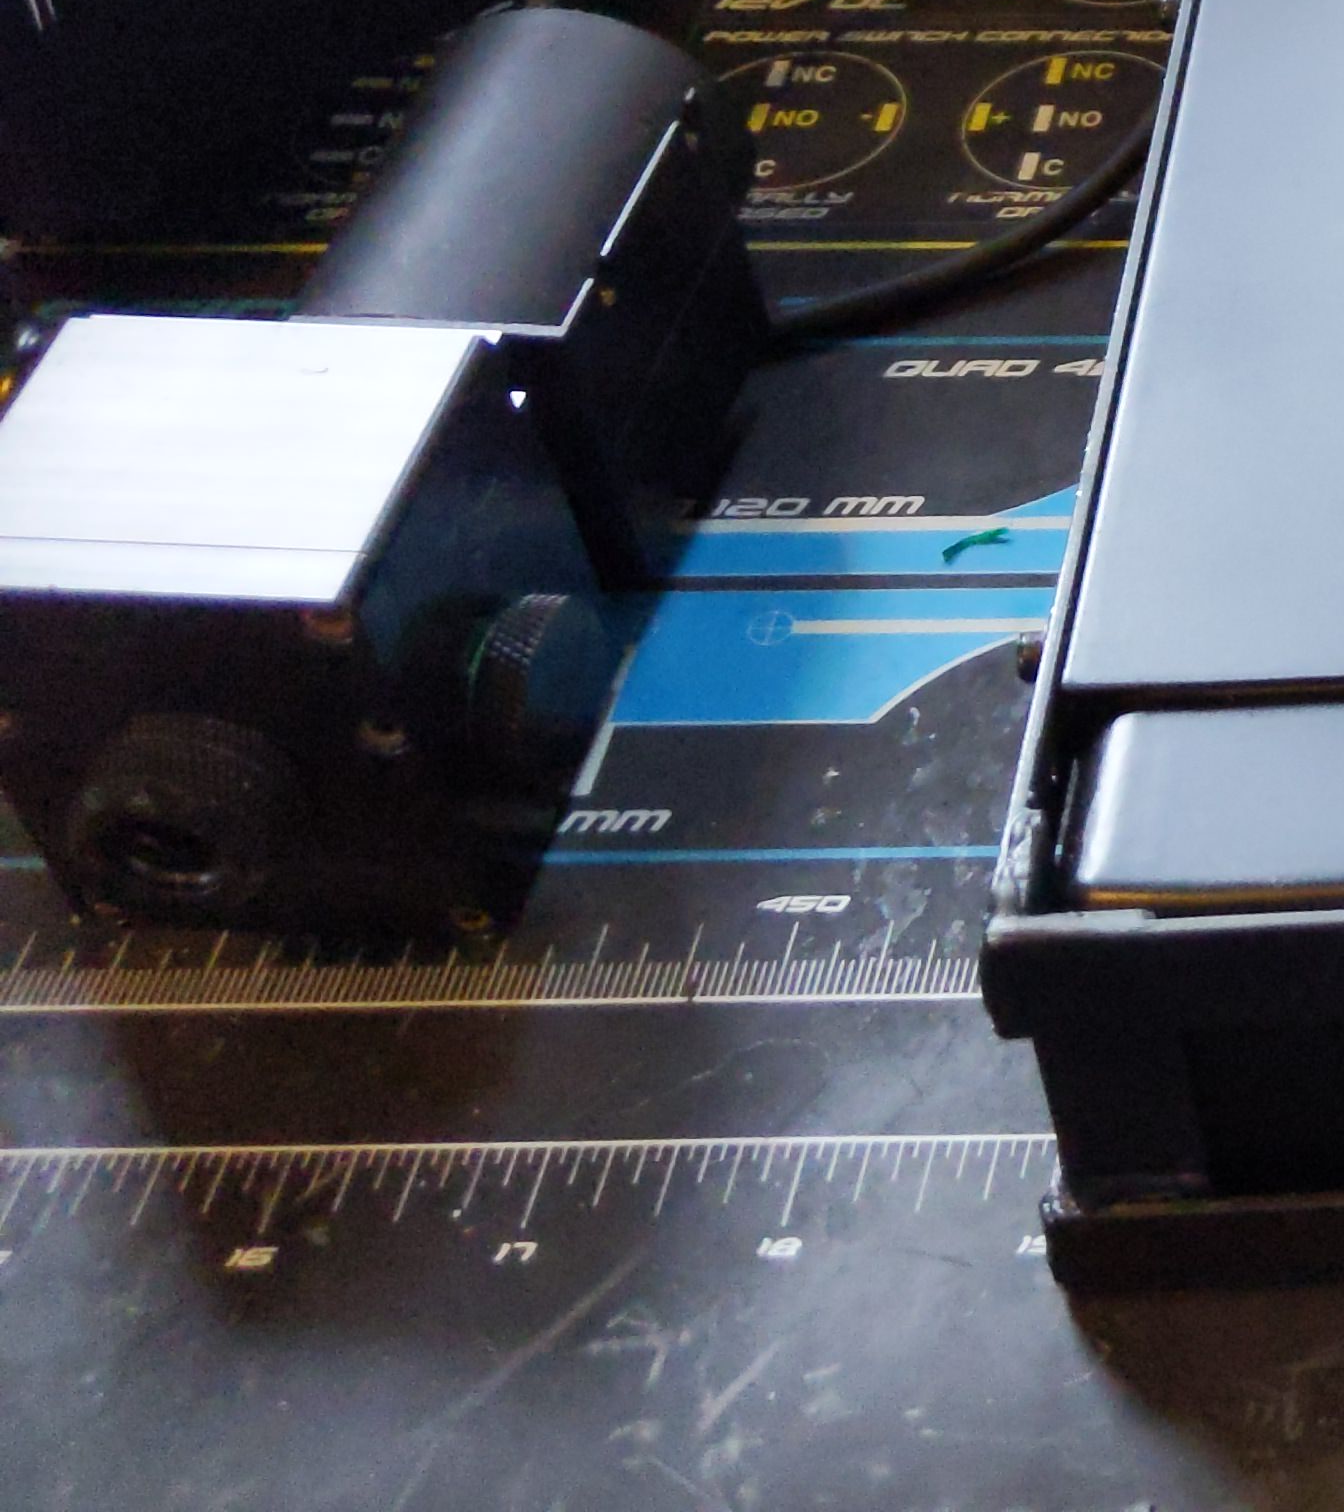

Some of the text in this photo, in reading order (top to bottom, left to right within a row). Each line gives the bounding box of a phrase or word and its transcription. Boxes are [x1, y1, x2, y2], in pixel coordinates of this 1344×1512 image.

[792, 65, 838, 83] NC
[1070, 62, 1116, 80] NC
[771, 109, 820, 127] NO
[1058, 109, 1103, 127] NO
[754, 159, 776, 177] C
[1043, 158, 1065, 176] C
[884, 358, 1041, 378] QUAD
[561, 808, 672, 832] mm
[756, 894, 852, 914] 450
[225, 1246, 279, 1268] 16
[493, 1240, 540, 1262] 17
[756, 1237, 803, 1258] 18
